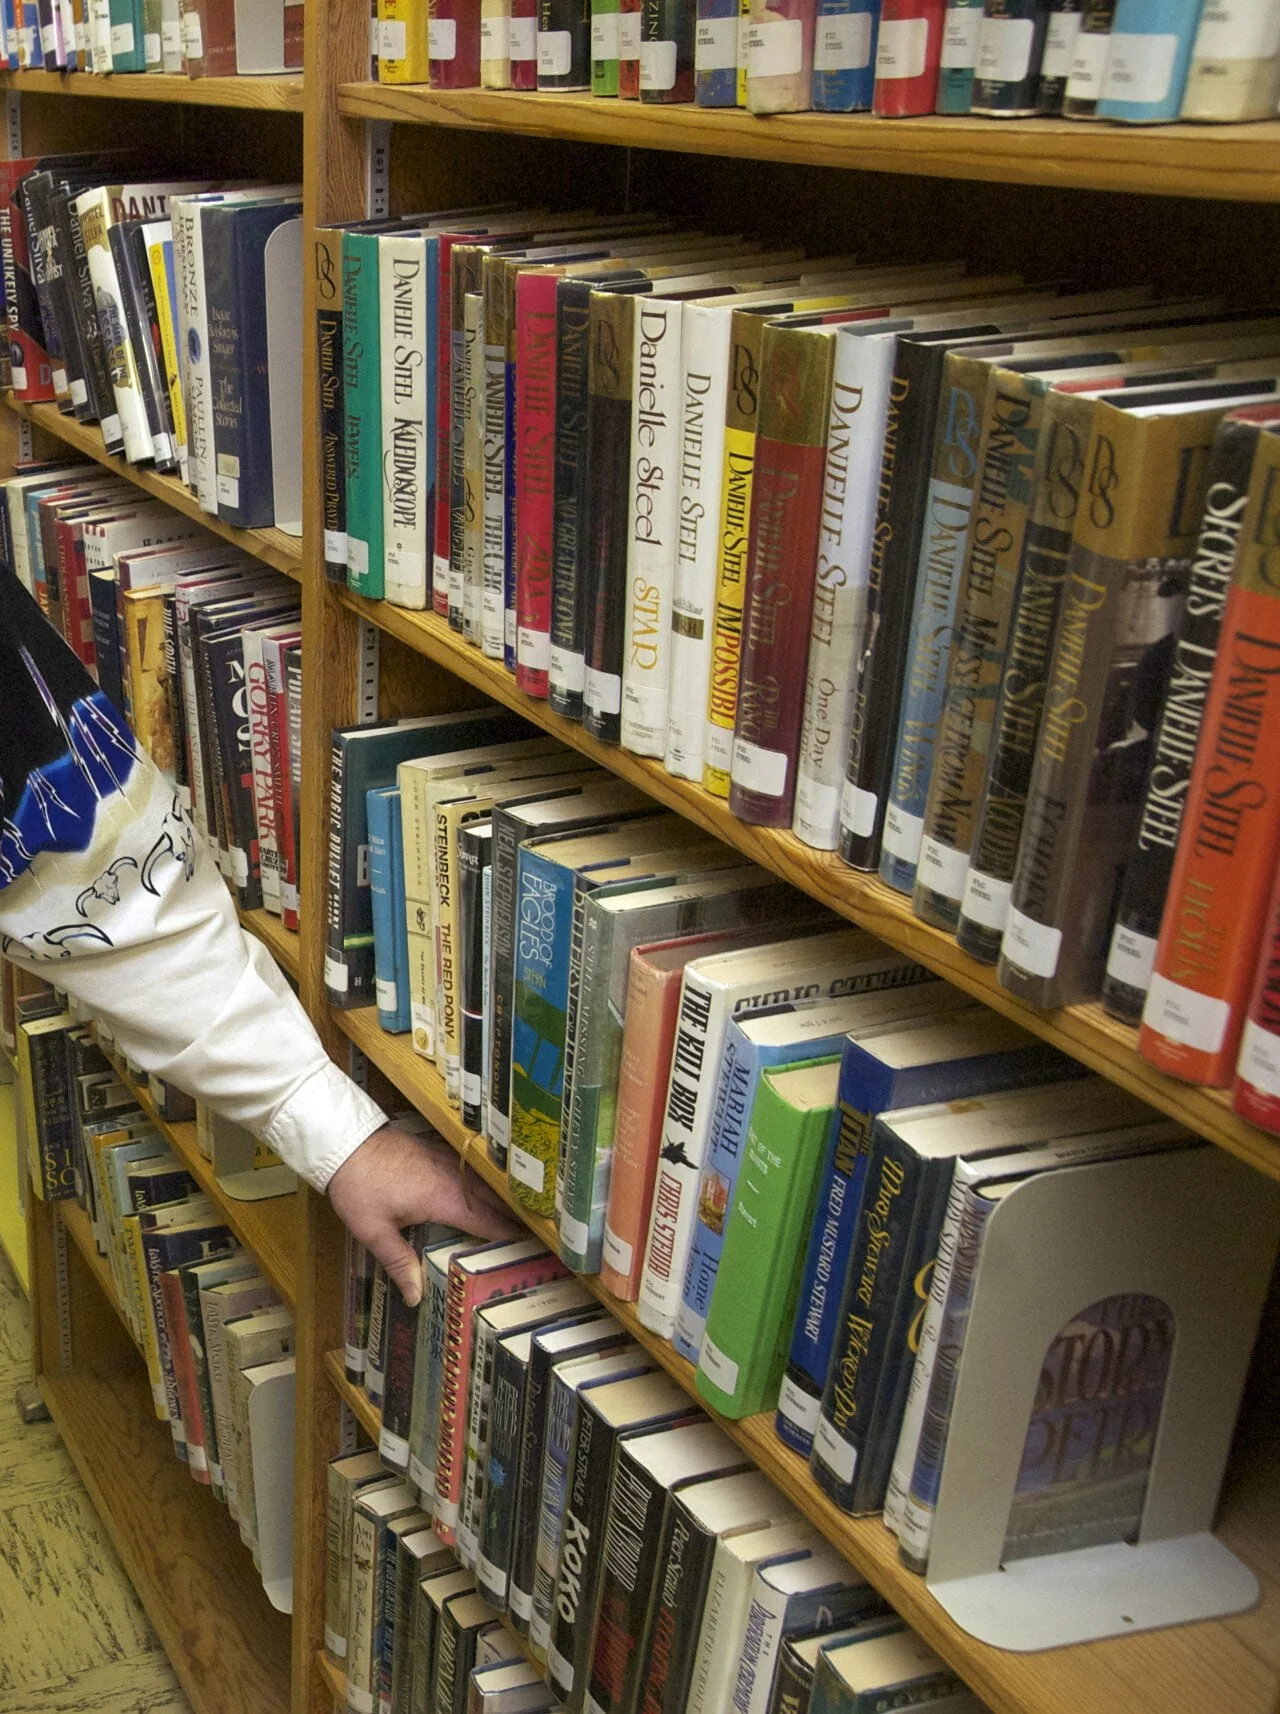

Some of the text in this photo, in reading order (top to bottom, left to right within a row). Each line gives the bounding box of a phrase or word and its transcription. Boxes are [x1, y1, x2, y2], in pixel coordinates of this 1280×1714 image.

[0, 237, 18, 303] UNLIKELY
[29, 239, 48, 284] Silva
[77, 263, 95, 309] Silva
[184, 217, 200, 317] BRONZE
[5, 304, 20, 332] SPY
[319, 319, 339, 408] DANIELLE STEEL
[343, 255, 363, 393] DANIELLE STEEL
[392, 258, 423, 404] DANIELLE STEEL
[559, 305, 590, 397] DANIELLE
[345, 413, 361, 481] JEWELS
[483, 358, 505, 500] DANIELLE STEEL
[521, 311, 555, 503] DANIELLE STEEL
[632, 309, 670, 545] Danielle Steel
[323, 430, 339, 490] ANSWERED
[383, 415, 423, 530] KALEIDOSCOPE
[674, 370, 709, 568] DANIELLE STEEL
[866, 373, 909, 592] DANIELLE STEEL
[963, 388, 1030, 607] DANIELLE STEEL
[484, 514, 503, 550] THE
[555, 520, 578, 589] GREATER
[720, 452, 748, 589] DANIELLE STEEL
[746, 466, 799, 652] DANIELLE STEEL
[807, 380, 864, 649] DANIELLE STEEL
[160, 605, 178, 675] JULIE SMITH
[553, 594, 577, 646] LOVE
[629, 574, 661, 671] STAR
[908, 496, 973, 700] DANIELLE STEEL
[997, 544, 1064, 760] DANIELLE STEEL
[1039, 570, 1108, 770] DANIELLE STEEL
[1133, 478, 1252, 858] SECRETS DANIELLE STEEL
[244, 661, 279, 840] GORKY PARK
[808, 676, 841, 769] One Day
[894, 709, 941, 806] WINGS
[939, 727, 974, 793] FROM
[1191, 629, 1280, 867] DANIELLE STEEL
[327, 746, 343, 889] THE MAGIC BULLET
[435, 813, 456, 1040] STEINBECK THE RED PONY
[493, 822, 515, 958] NEAL STEPHENSON
[513, 871, 548, 960] EAGLES
[535, 879, 559, 969] BROOD OF
[575, 942, 596, 1077] STILL MISSING
[664, 981, 713, 1133] THE KILL BOX
[569, 1094, 584, 1151] CHEVY
[716, 1057, 753, 1159] MARIAH
[823, 1096, 876, 1180] TITAN
[652, 1168, 684, 1222] CHRIS
[691, 1249, 721, 1312] Home
[800, 1173, 848, 1345] FRED MUSTARD STEWART
[470, 1336, 485, 1434] PETER STRAUB
[570, 1409, 595, 1506] PETER STRAUB
[354, 1522, 372, 1537] AMY
[354, 1537, 372, 1553] TAN
[548, 1507, 594, 1626] KOKO
[660, 1517, 693, 1609] Peter Straub
[690, 1569, 727, 1713] ELIZABETH STROUT
[760, 1631, 773, 1657] THE
